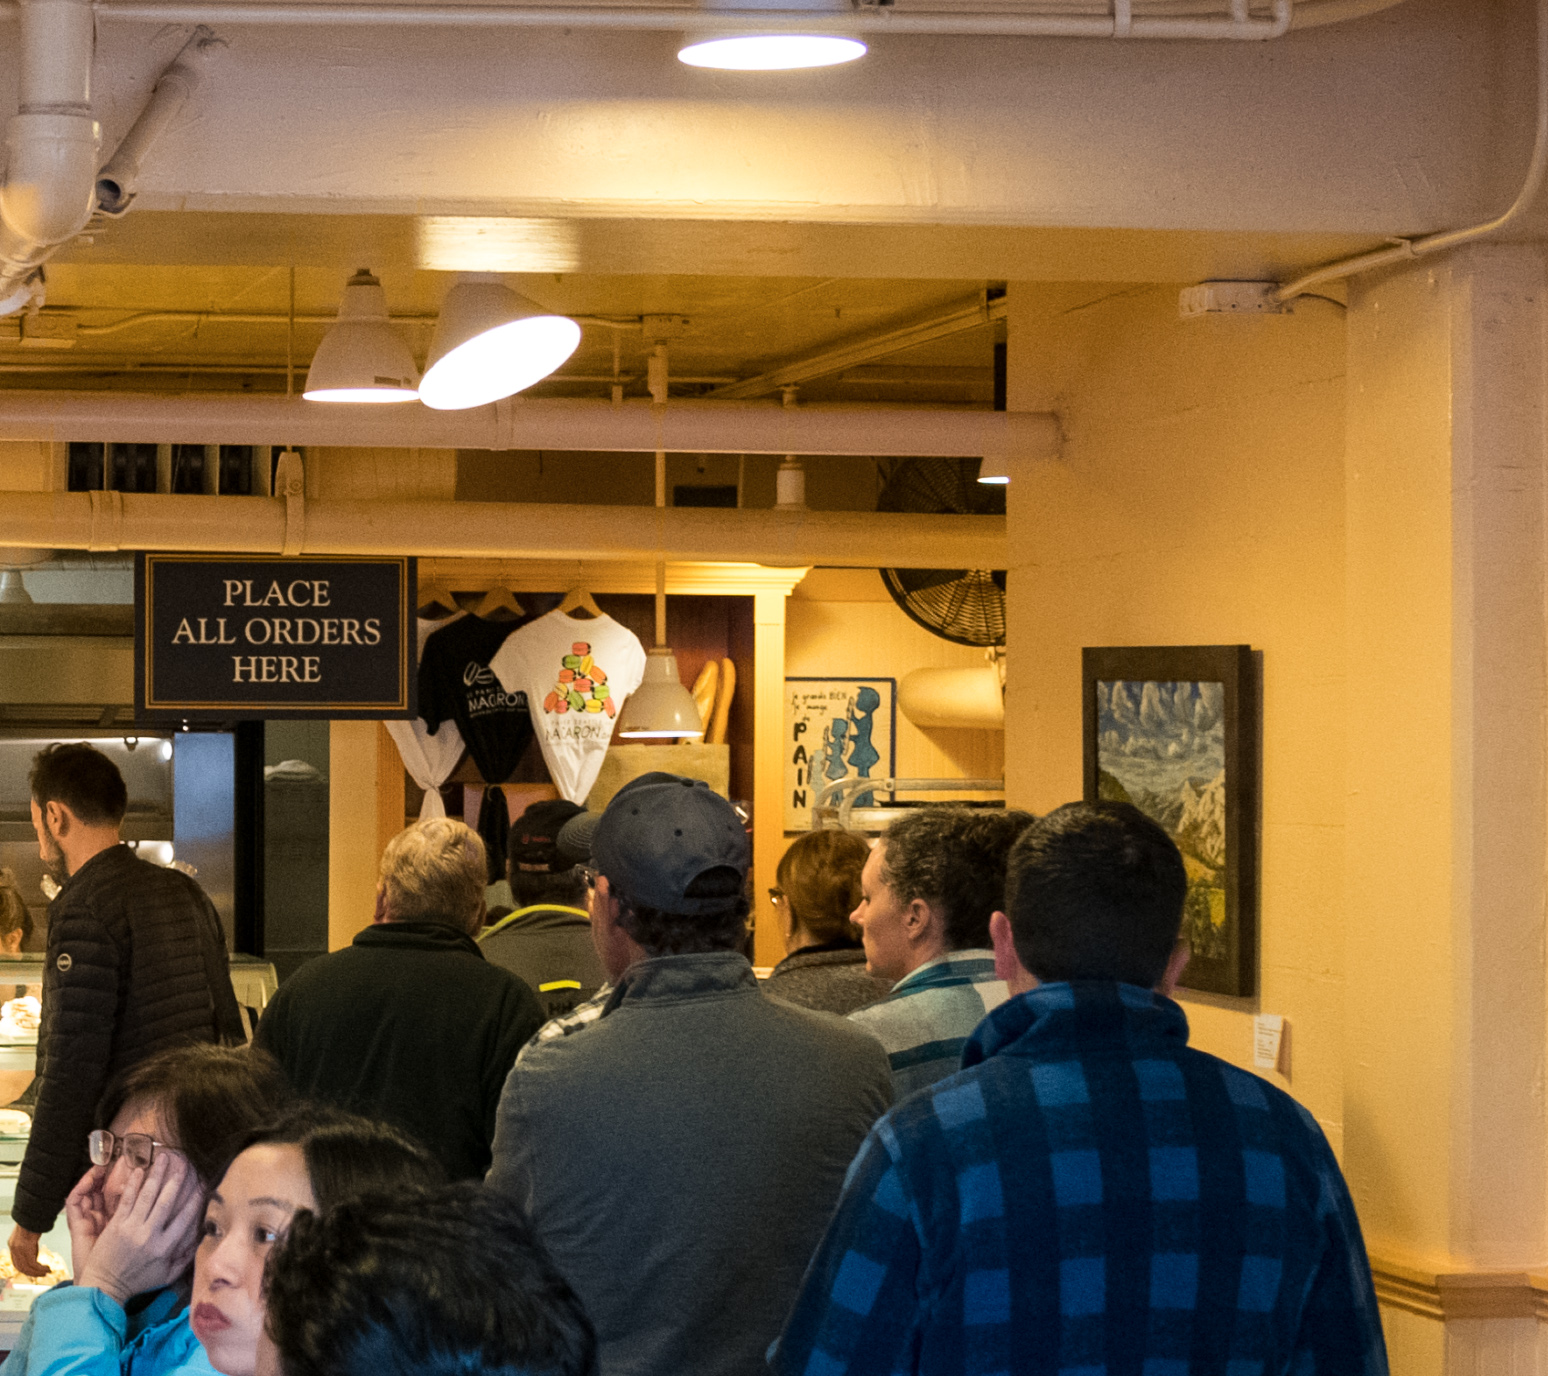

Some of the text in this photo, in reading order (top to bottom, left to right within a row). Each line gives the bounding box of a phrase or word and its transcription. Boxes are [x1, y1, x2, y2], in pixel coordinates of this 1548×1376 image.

[223, 579, 331, 607] PLACE
[171, 617, 382, 646] ALL ORDERS
[231, 656, 322, 683] HERE
[793, 722, 808, 808] PAIN
